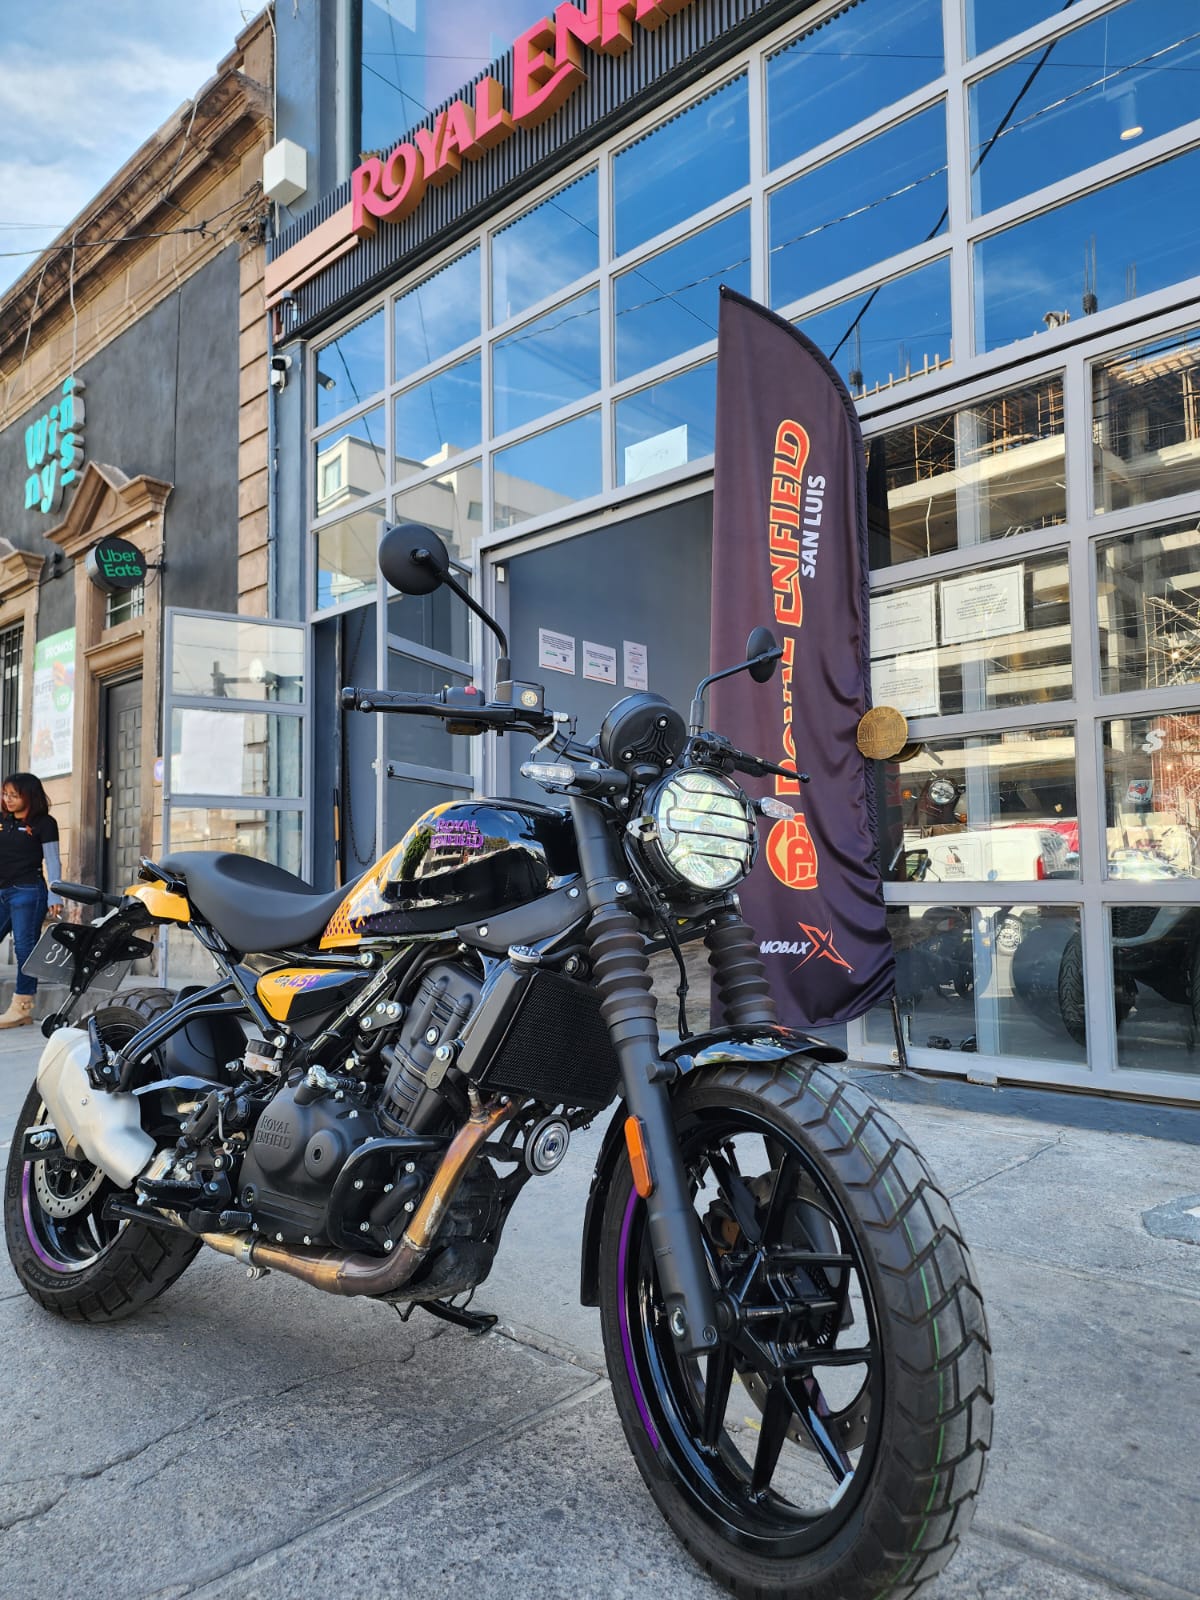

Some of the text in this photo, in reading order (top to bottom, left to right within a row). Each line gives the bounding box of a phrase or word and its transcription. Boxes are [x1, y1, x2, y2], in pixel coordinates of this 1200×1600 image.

[351, 76, 512, 238] ROYAL
[801, 475, 826, 578] SAN LUIS
[99, 548, 137, 563] Uber
[103, 563, 143, 577] Eats
[435, 817, 479, 834] ROYAL
[430, 833, 484, 849] ENFIELD
[260, 1114, 291, 1135] ROYAL
[255, 1129, 292, 1150] ENFIELD
